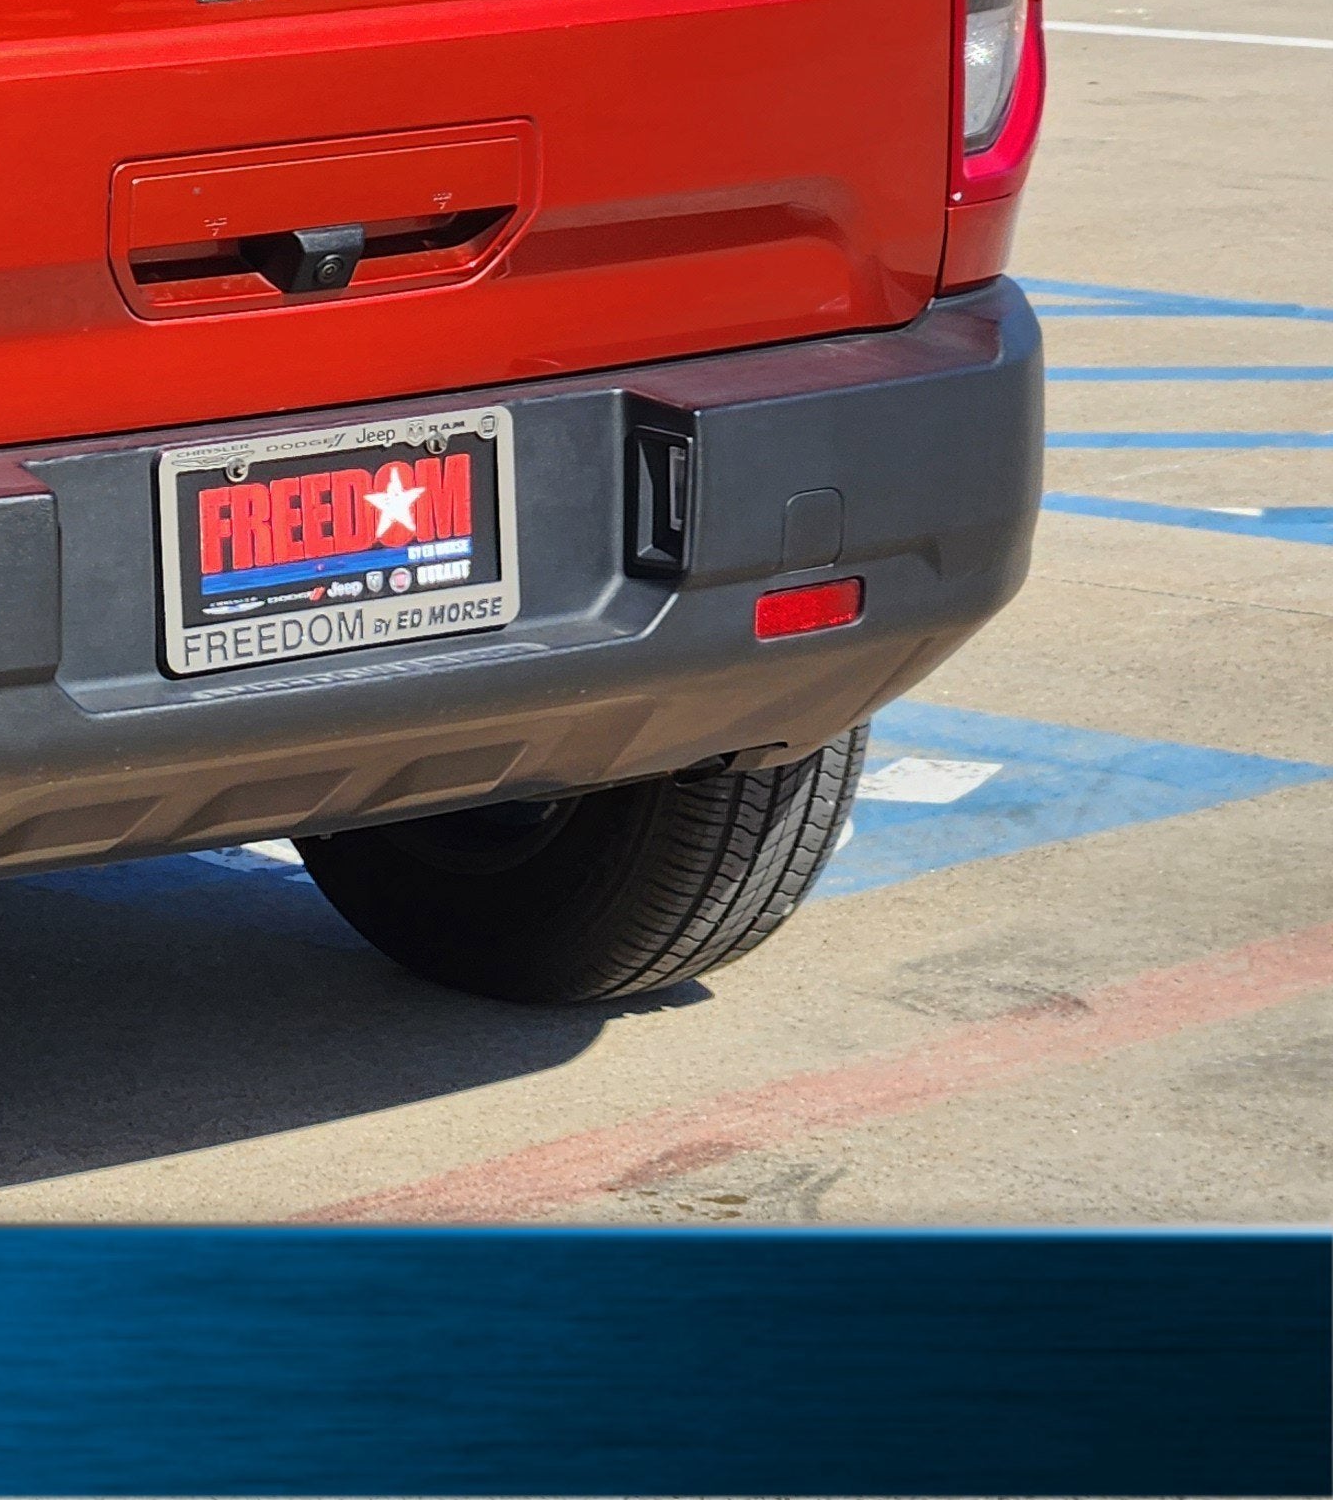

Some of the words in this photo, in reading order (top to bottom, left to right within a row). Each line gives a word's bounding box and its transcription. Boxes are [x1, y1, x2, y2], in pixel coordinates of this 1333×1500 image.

[175, 442, 250, 458] CHRYSLER
[265, 437, 333, 453] DODGE
[355, 427, 396, 445] Jeep
[428, 420, 466, 433] RAM
[198, 453, 473, 575] FREEDOM
[183, 608, 365, 668] FREEDOM
[396, 608, 422, 631] ED
[428, 596, 503, 627] MORSE
